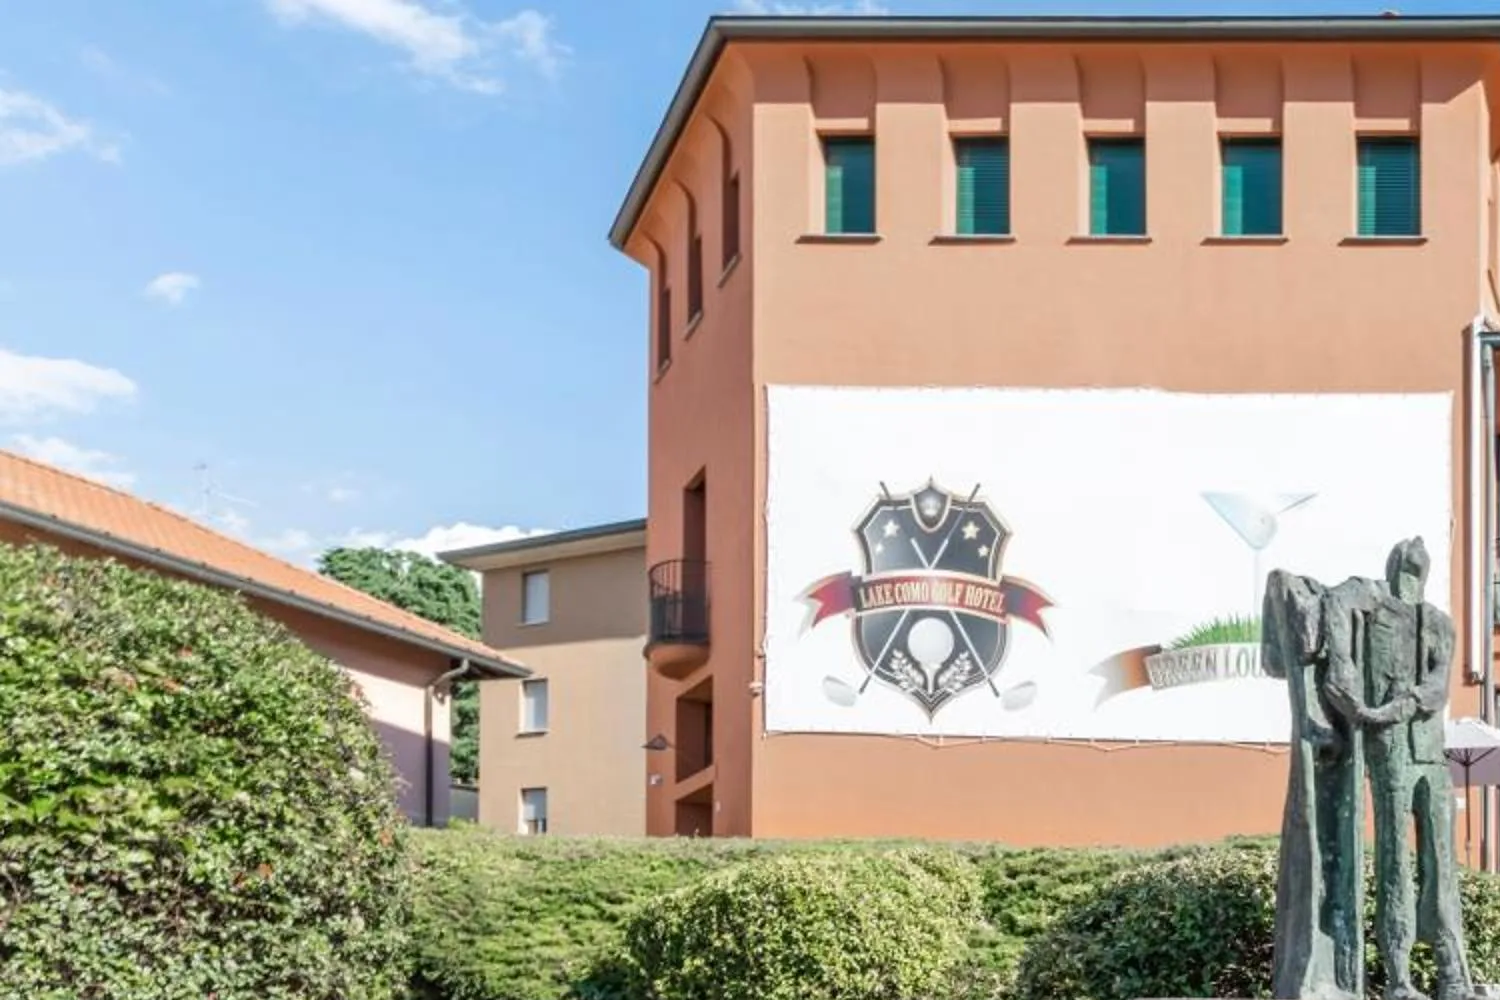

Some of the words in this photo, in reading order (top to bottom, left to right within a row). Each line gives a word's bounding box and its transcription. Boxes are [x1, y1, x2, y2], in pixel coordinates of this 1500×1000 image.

[859, 583, 895, 608] LAKE
[895, 580, 929, 604] COMO
[931, 580, 964, 606] GOLF
[965, 583, 1005, 613] HOTEL
[1224, 645, 1262, 679] LOU
